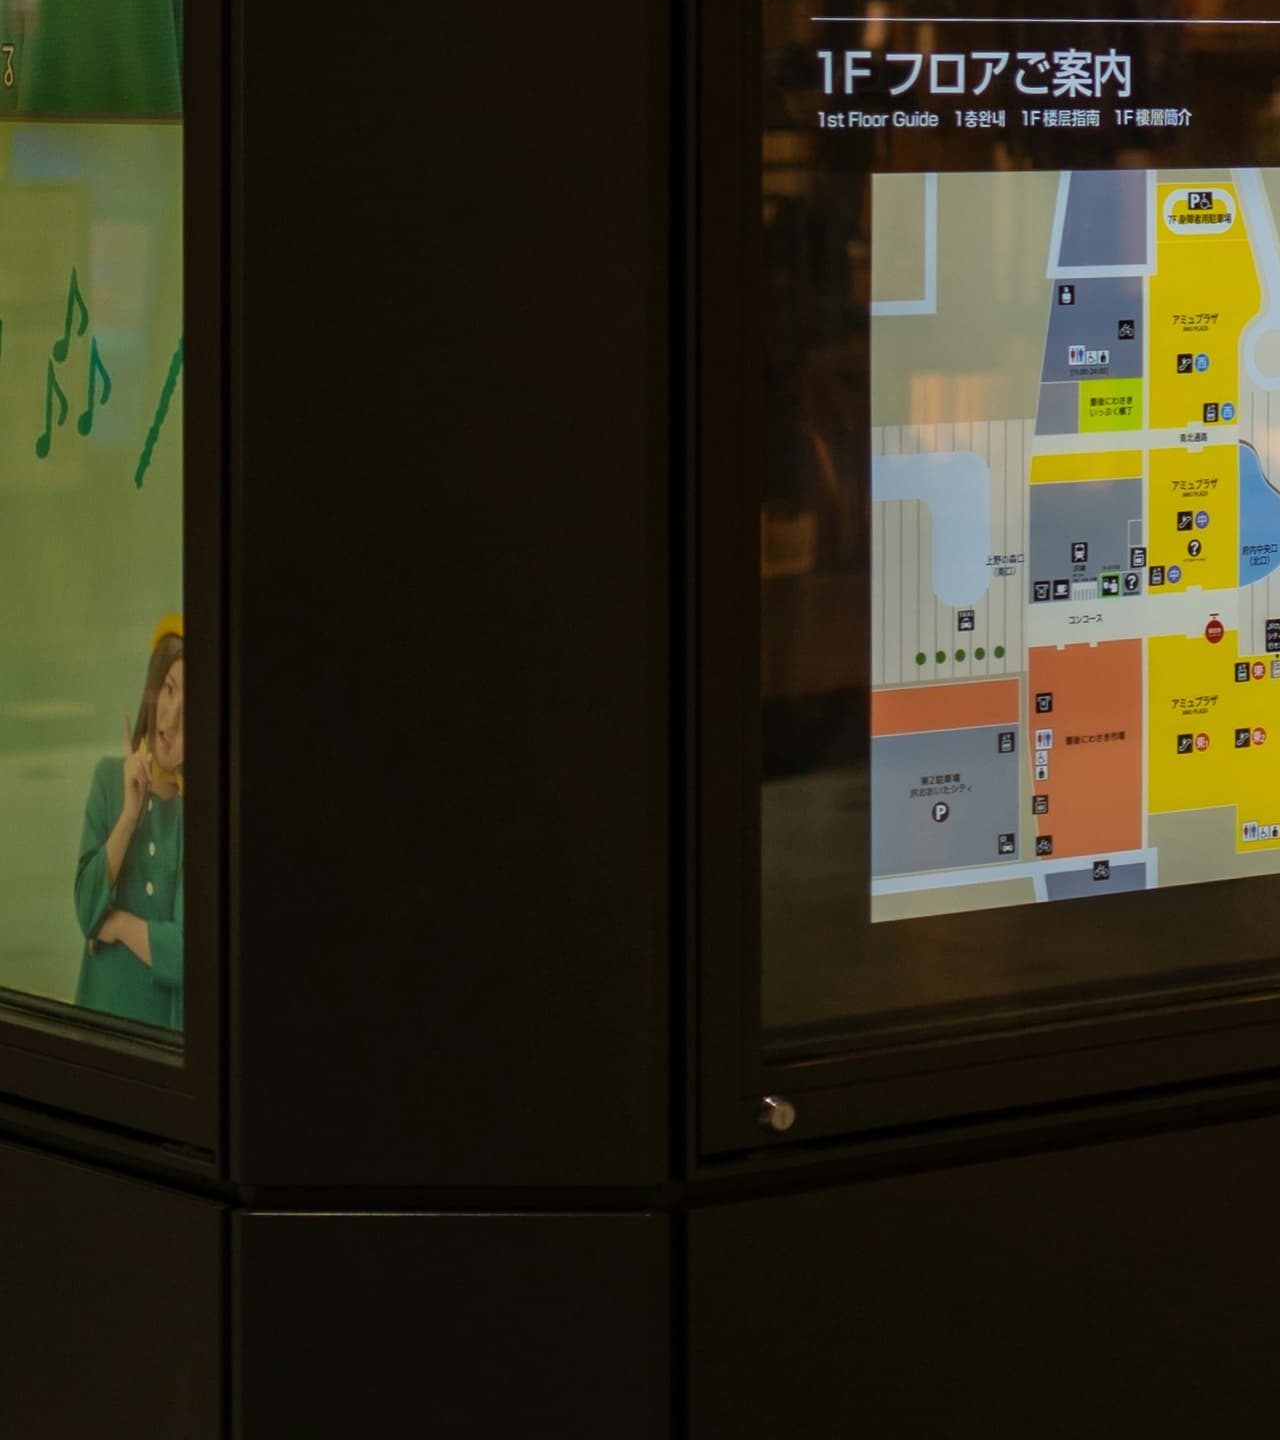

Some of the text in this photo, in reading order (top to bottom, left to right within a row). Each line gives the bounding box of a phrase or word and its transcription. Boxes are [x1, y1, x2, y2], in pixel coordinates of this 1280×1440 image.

[816, 48, 1132, 98] 1F フロアご案内
[817, 110, 939, 129] 1st Floor Guide
[1021, 109, 1041, 126] 1F
[1115, 109, 1134, 126] 1F
